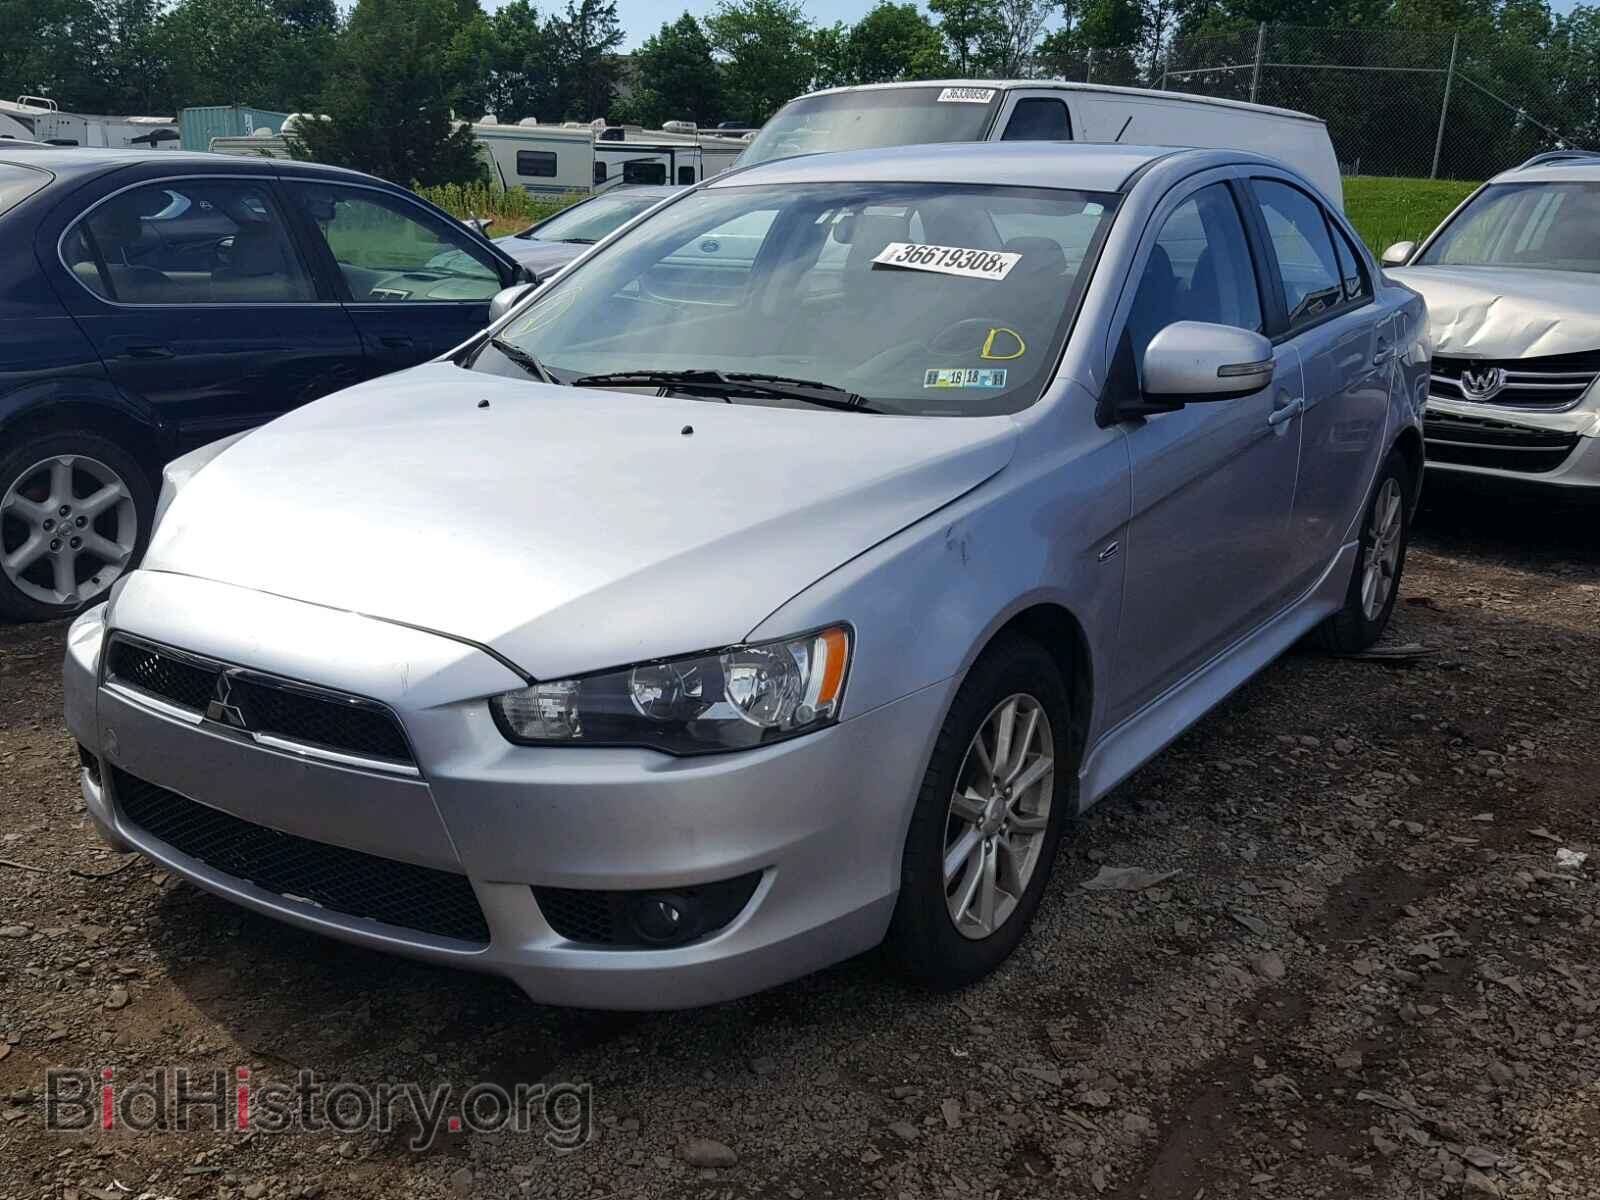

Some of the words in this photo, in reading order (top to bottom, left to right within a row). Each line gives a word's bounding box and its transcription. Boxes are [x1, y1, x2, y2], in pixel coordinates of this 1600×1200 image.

[980, 327, 1026, 360] D
[950, 370, 963, 385] 18
[966, 370, 979, 384] 18
